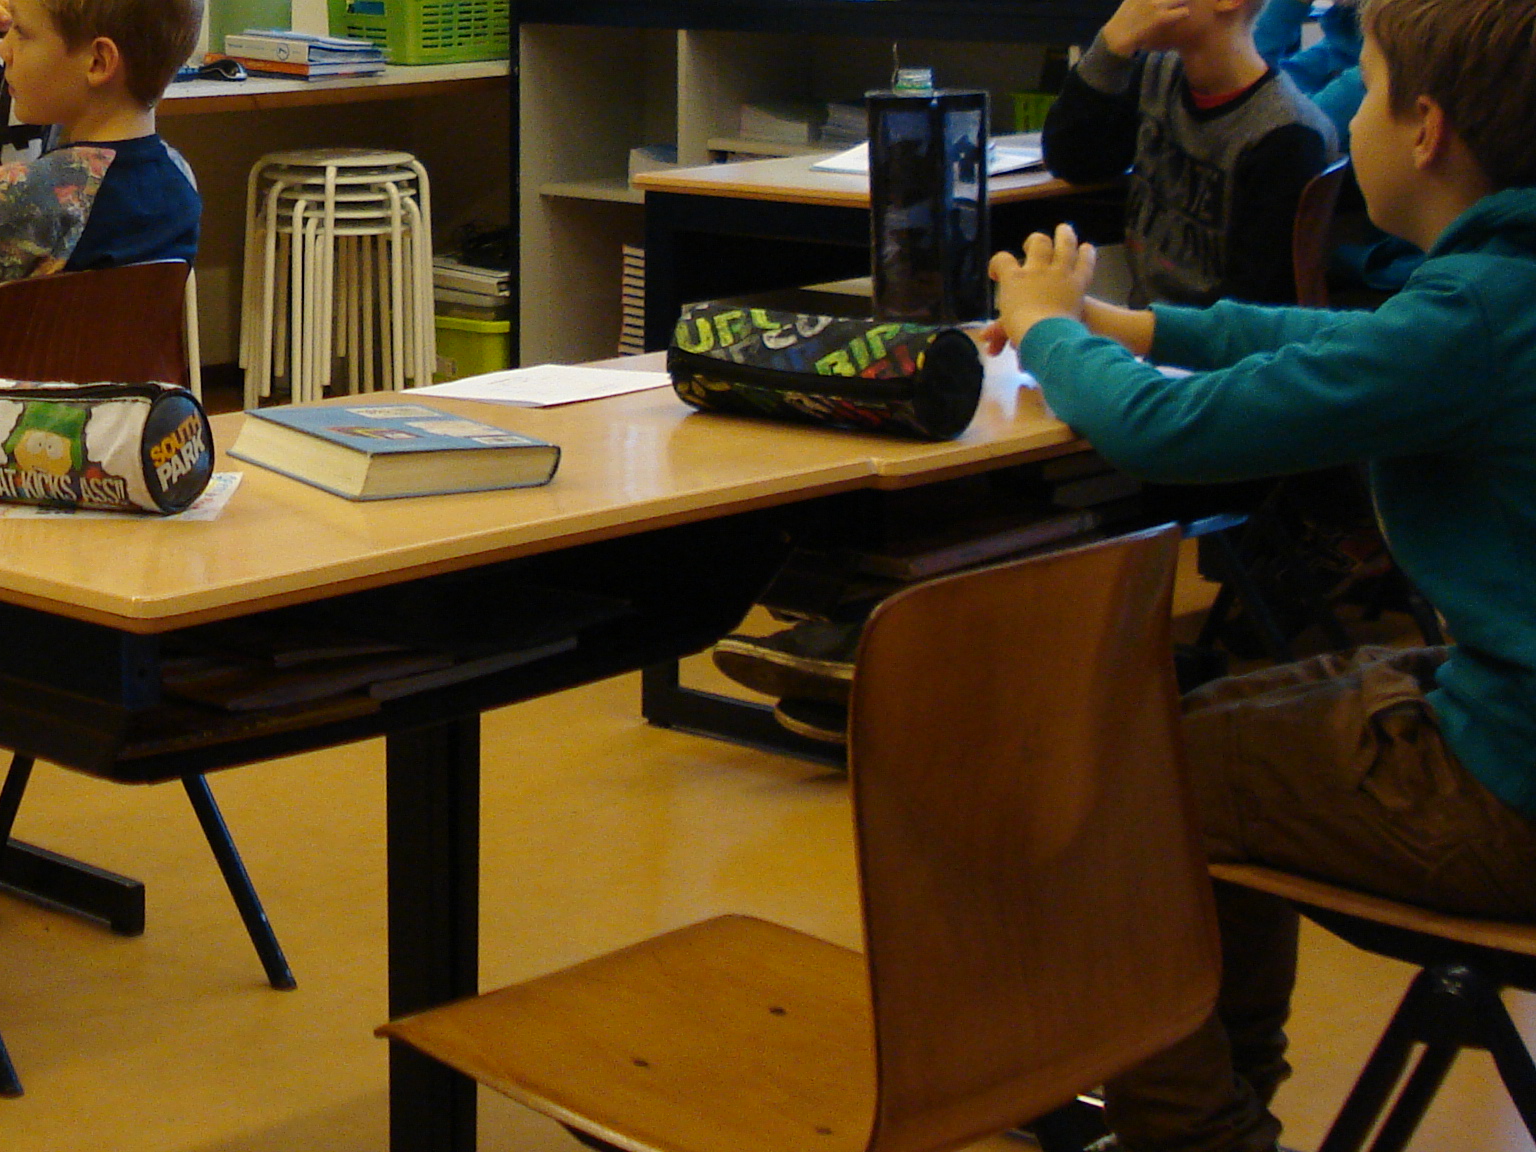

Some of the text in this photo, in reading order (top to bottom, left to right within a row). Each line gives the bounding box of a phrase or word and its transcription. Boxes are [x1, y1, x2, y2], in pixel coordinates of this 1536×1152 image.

[150, 408, 203, 469] SOUTH
[156, 427, 206, 493] PARK
[21, 470, 78, 502] KICKS
